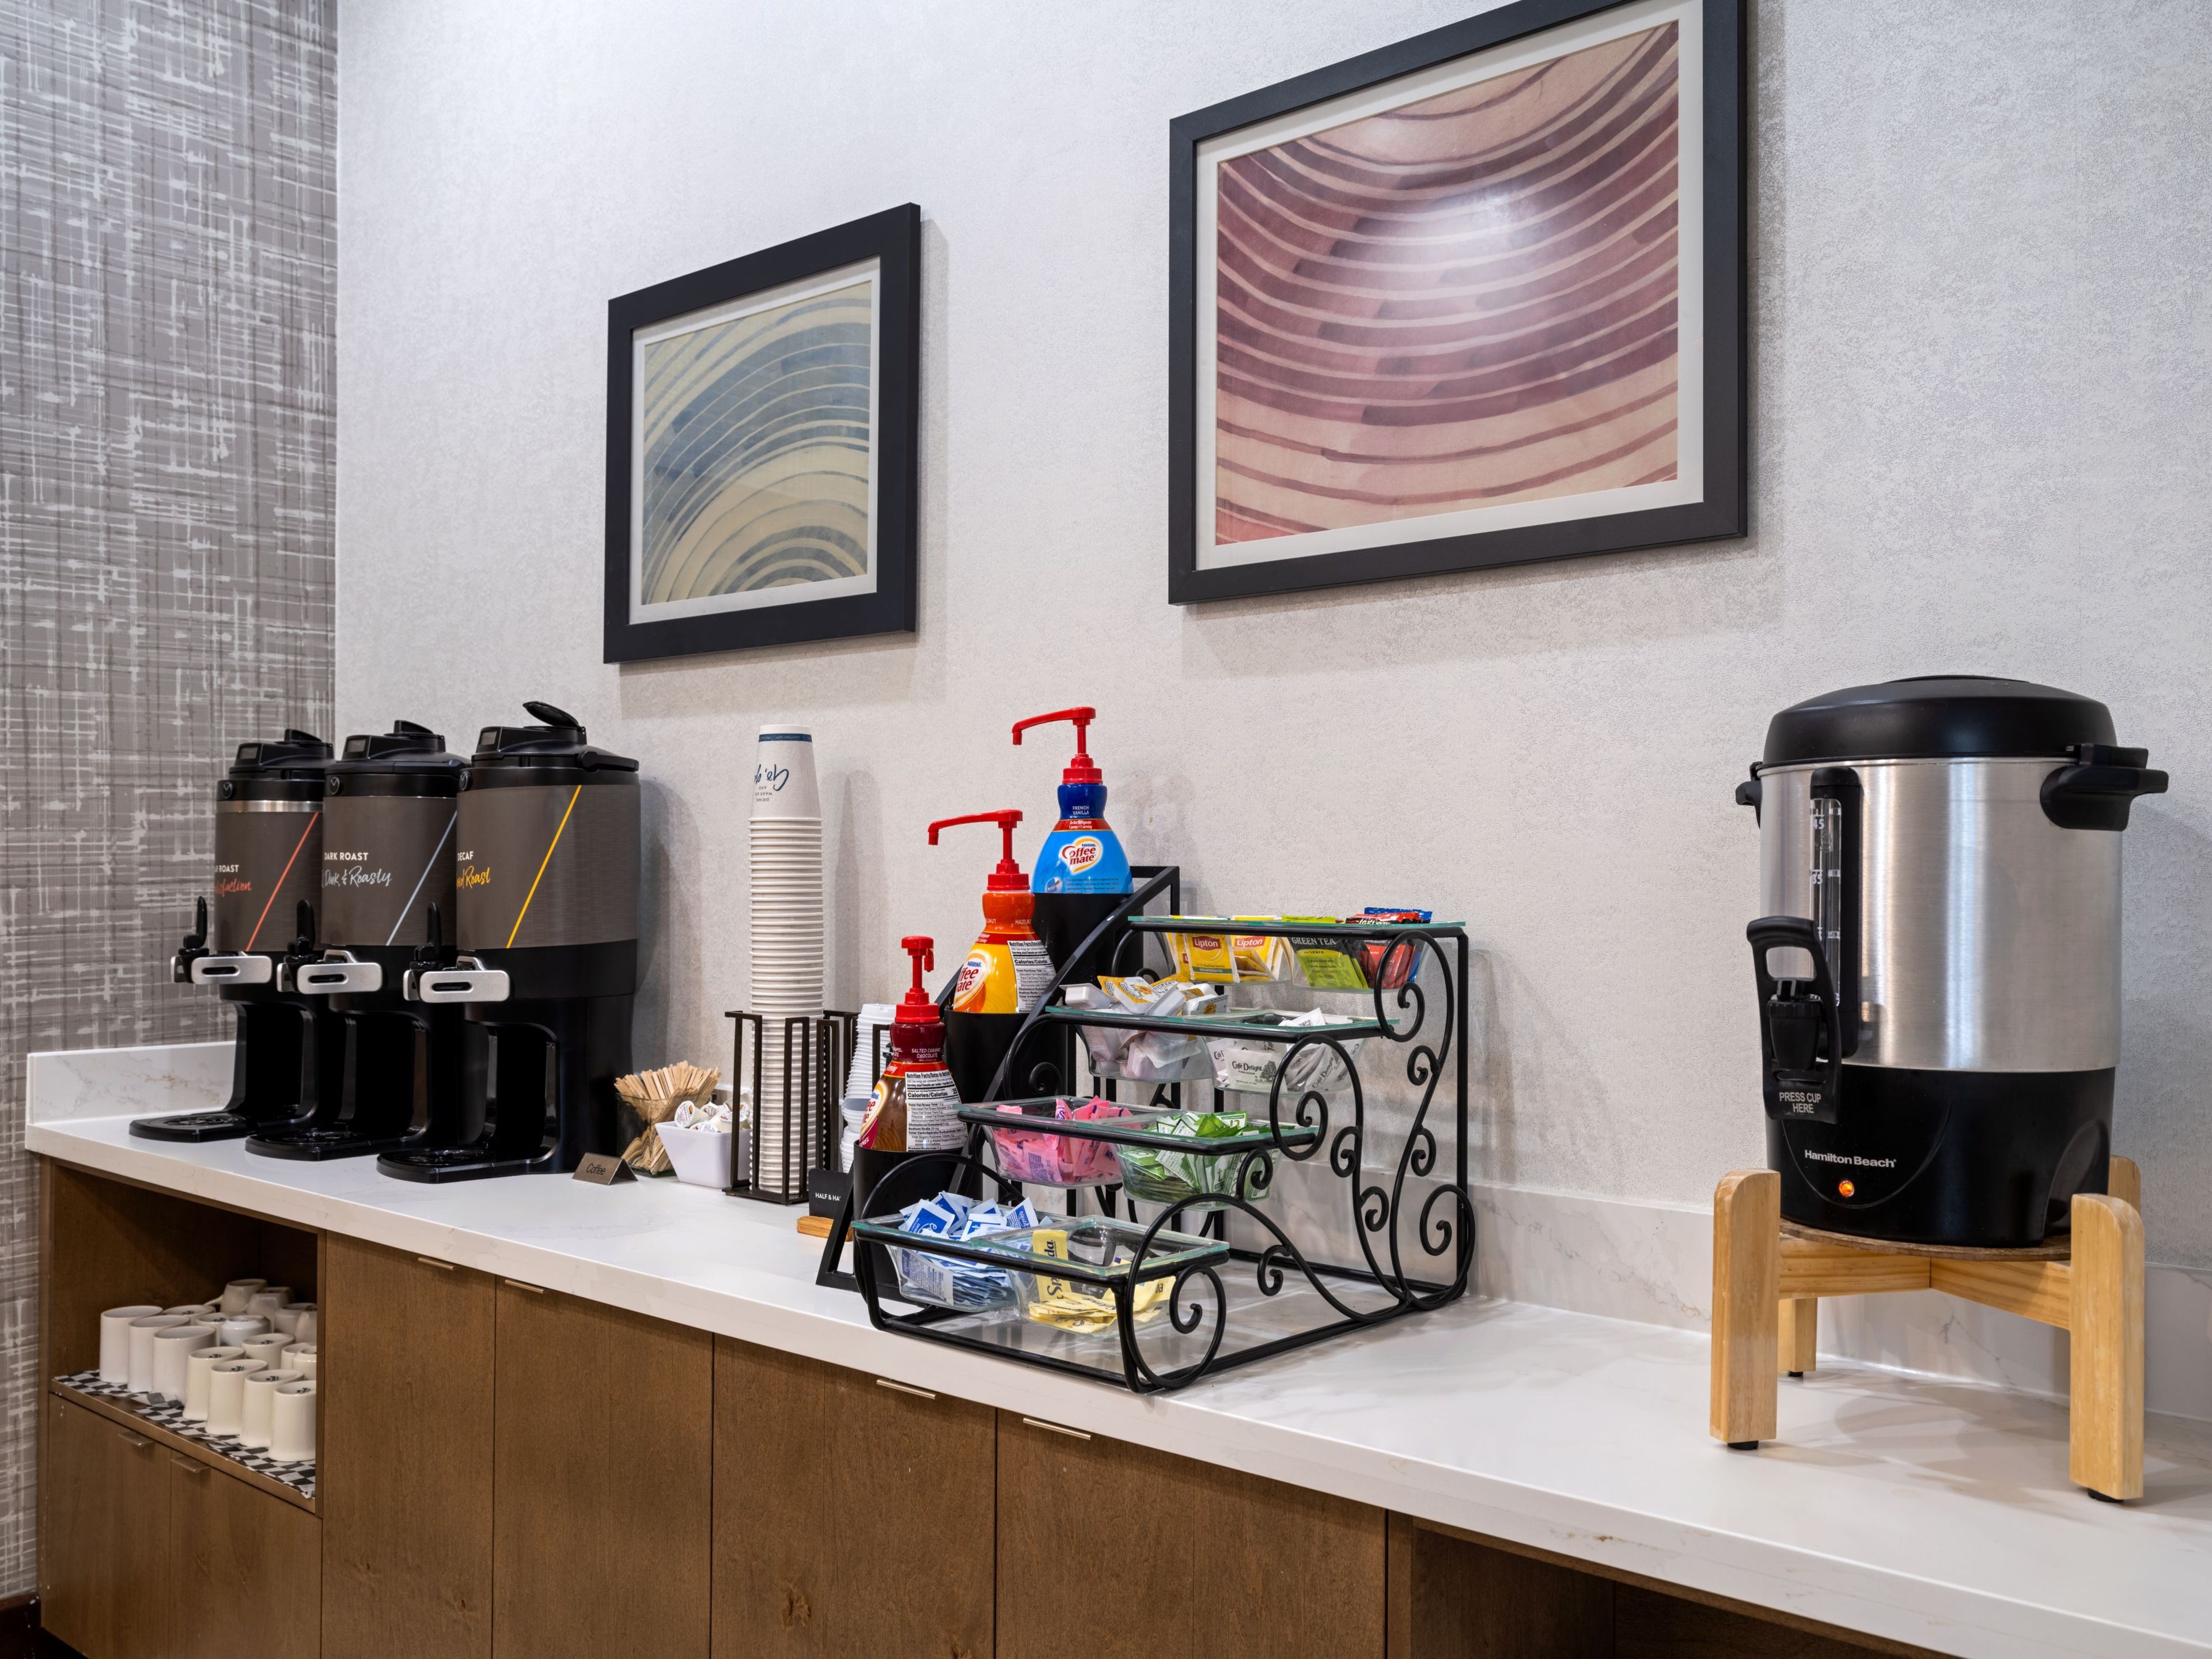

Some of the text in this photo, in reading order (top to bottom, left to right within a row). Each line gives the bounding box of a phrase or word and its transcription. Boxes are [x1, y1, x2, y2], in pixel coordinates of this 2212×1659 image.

[1813, 818, 1825, 830] 45
[324, 852, 369, 861] DARK ROAST
[457, 851, 474, 861] DECAF
[1062, 846, 1096, 859] Coffee
[1070, 855, 1094, 865] mate
[218, 865, 240, 873] ROAST
[341, 869, 347, 885] &
[349, 865, 393, 887] Roasty
[465, 865, 491, 889] Roast
[1194, 938, 1219, 948] Lipton
[1236, 938, 1263, 948] Lipton
[1291, 937, 1319, 945] GREEN
[960, 968, 979, 982] ffee
[1232, 1060, 1262, 1071] Café Delight
[1779, 1092, 1821, 1103] PRESS CUP
[1793, 1103, 1815, 1113] HERE
[1804, 1149, 1853, 1165] Hamilton
[586, 1163, 607, 1176] Coffee
